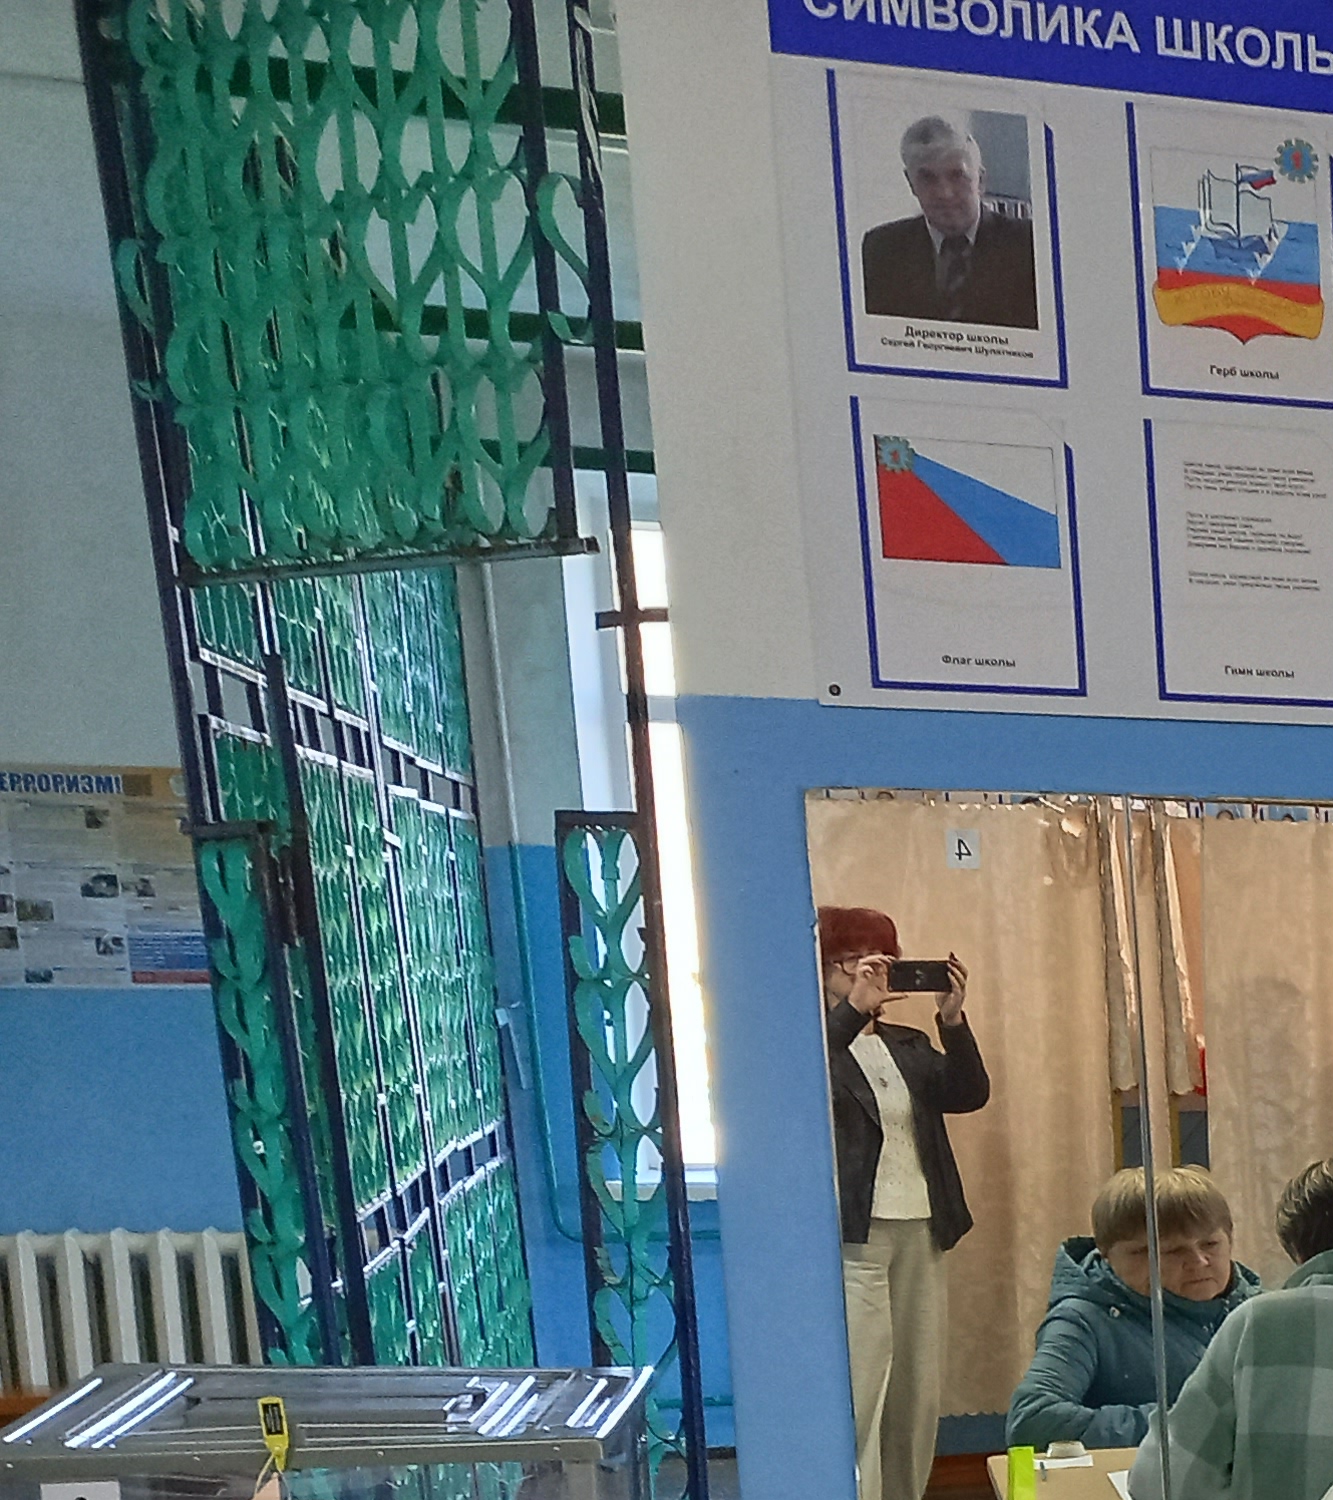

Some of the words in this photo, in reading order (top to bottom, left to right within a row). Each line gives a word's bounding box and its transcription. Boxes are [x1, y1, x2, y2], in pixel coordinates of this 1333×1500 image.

[904, 325, 964, 341] Директор
[966, 335, 1009, 345] школы
[1209, 365, 1236, 378] Герб
[1239, 369, 1280, 380] школы
[941, 655, 972, 667] Флаг
[974, 657, 1016, 668] школы
[1224, 665, 1254, 676] Гимн
[1255, 668, 1295, 679] школы
